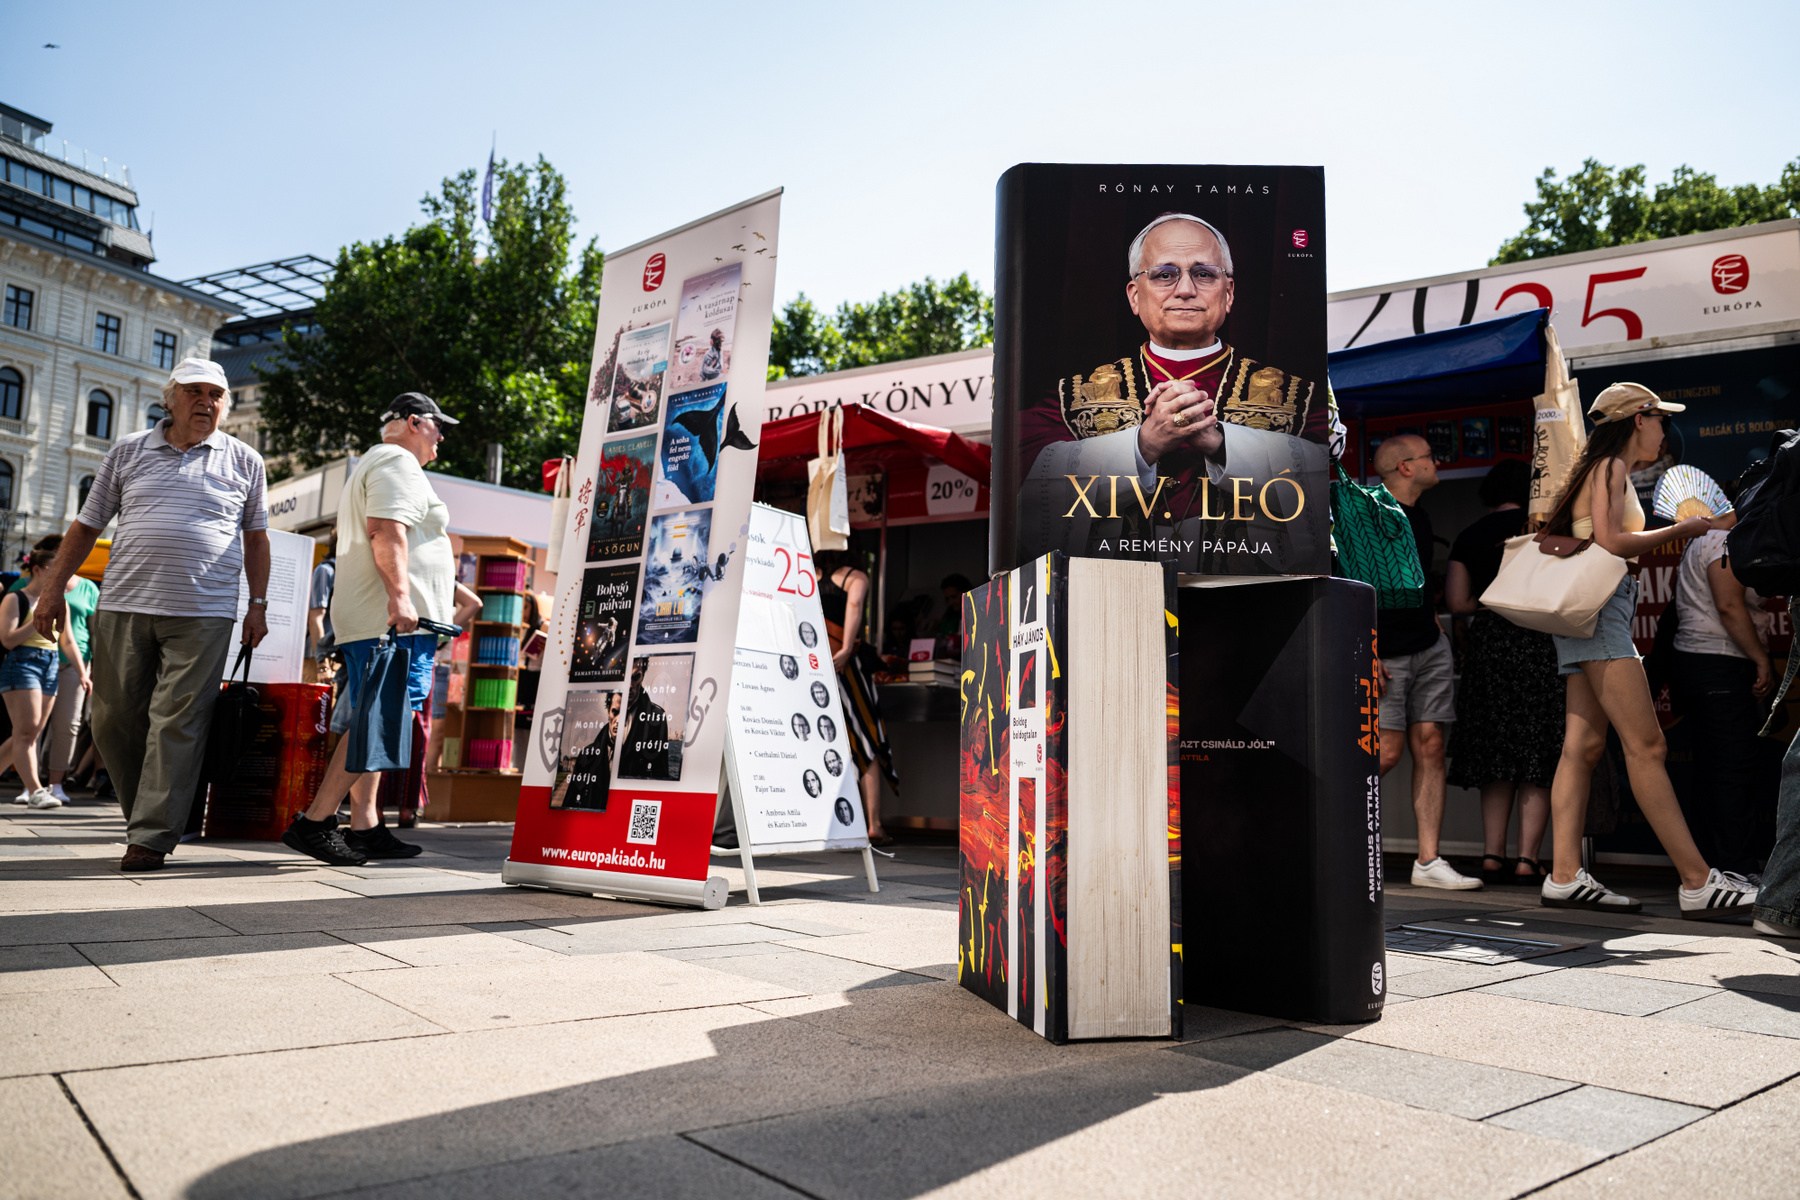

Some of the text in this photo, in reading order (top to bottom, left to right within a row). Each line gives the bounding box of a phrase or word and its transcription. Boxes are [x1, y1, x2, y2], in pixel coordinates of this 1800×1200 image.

[1100, 183, 1270, 195] RÓNAY TAMÁS
[632, 298, 667, 314] EURÓPA
[1703, 300, 1762, 315] EURÓPA
[763, 375, 991, 422] RÓP KÖNYV
[1699, 422, 1733, 438] BALGÁK
[1735, 420, 1746, 434] ÉS
[605, 440, 653, 454] JAMES CLAVELL
[931, 478, 974, 500] 20%
[1062, 469, 1305, 523] XIV. LEÓ
[268, 492, 297, 518] KIADÓ
[1099, 536, 1272, 555] A REMÉNY PÁPÁJA
[746, 556, 775, 568] nyvkiadó
[774, 547, 816, 598] 25
[596, 581, 629, 597] Bolygó
[599, 597, 632, 614] pályán
[1013, 627, 1044, 648] HÁY JÁNOS
[643, 685, 676, 694] Monte
[575, 720, 604, 729] Monte
[639, 711, 673, 722] Cristo
[1012, 716, 1027, 729] Boldog
[1358, 678, 1372, 756] ÁLLJ
[570, 746, 601, 756] Cristo
[635, 739, 669, 752] grófja
[1180, 740, 1200, 749] AZT
[1201, 738, 1245, 749] CSINÁLD
[1180, 754, 1210, 762] ATTILA
[566, 772, 597, 785] grófja
[1366, 775, 1376, 903] AMBRUS ATTILA
[542, 846, 666, 870] www.europakiado.hu
